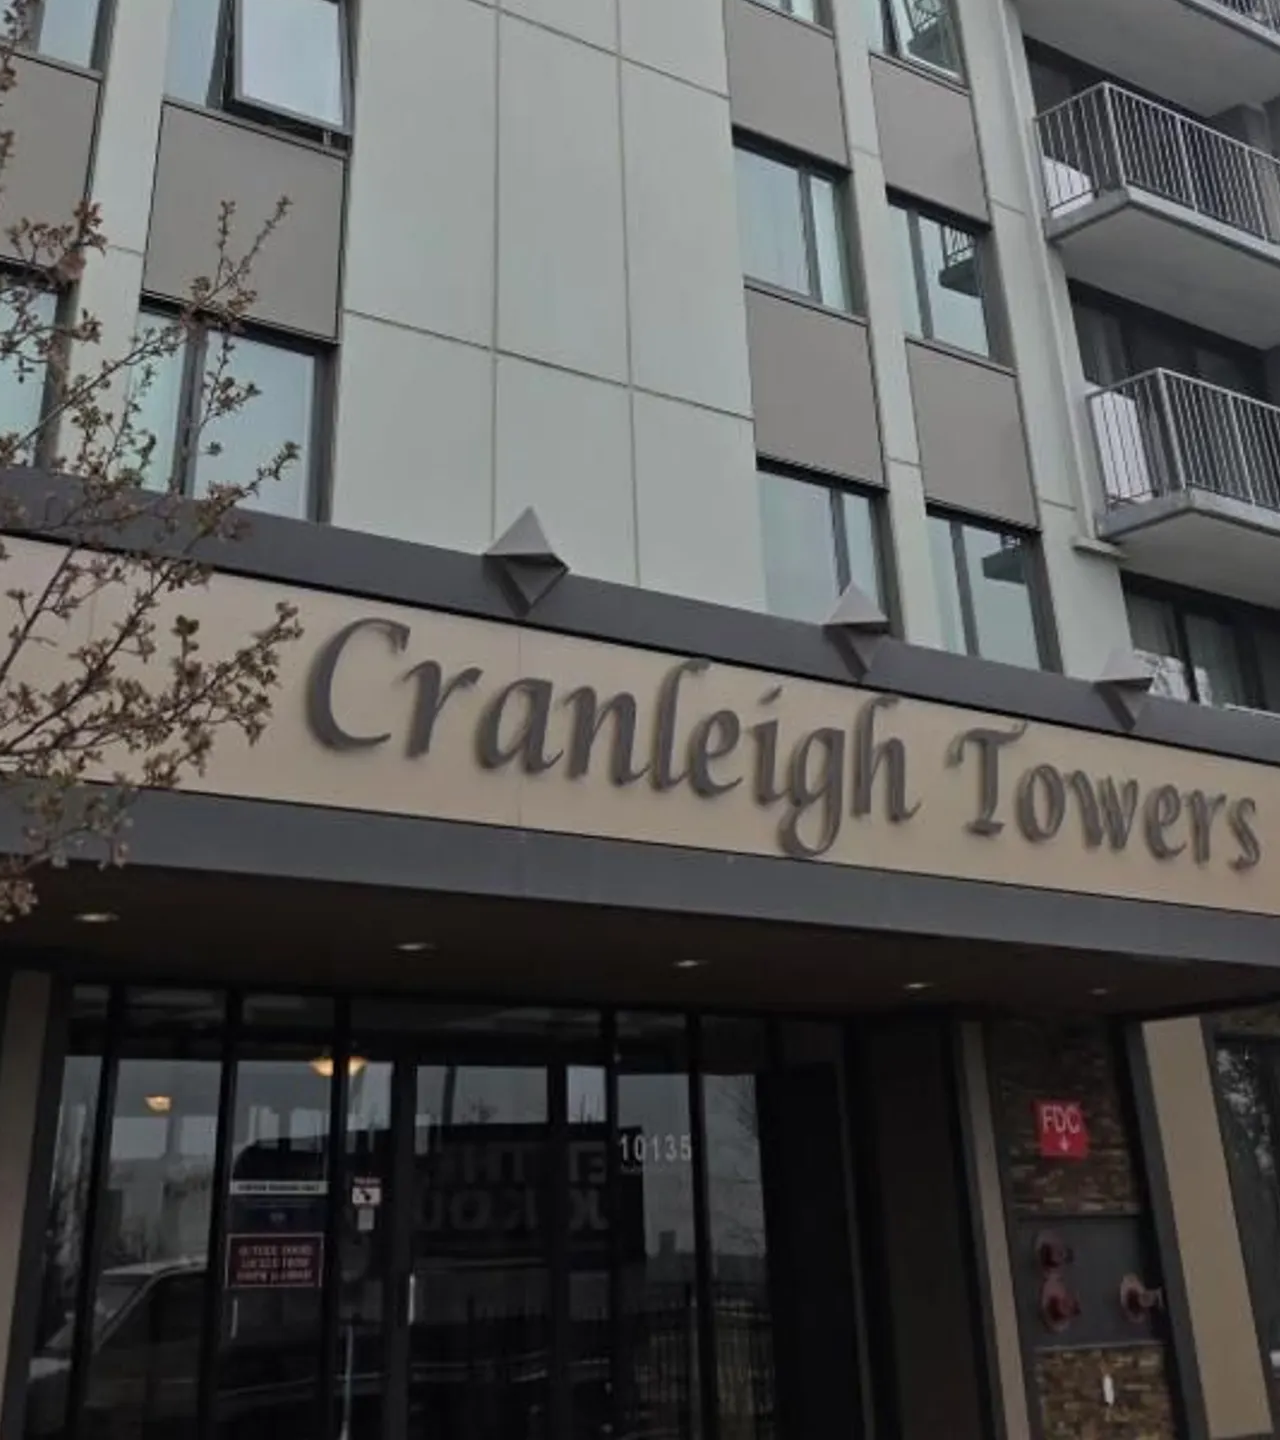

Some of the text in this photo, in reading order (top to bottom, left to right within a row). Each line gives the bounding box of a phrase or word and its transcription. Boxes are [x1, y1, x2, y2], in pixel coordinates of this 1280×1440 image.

[306, 616, 1261, 870] Cranleigh Towers
[1039, 1102, 1081, 1134] FDC
[619, 1133, 692, 1162] 10135
